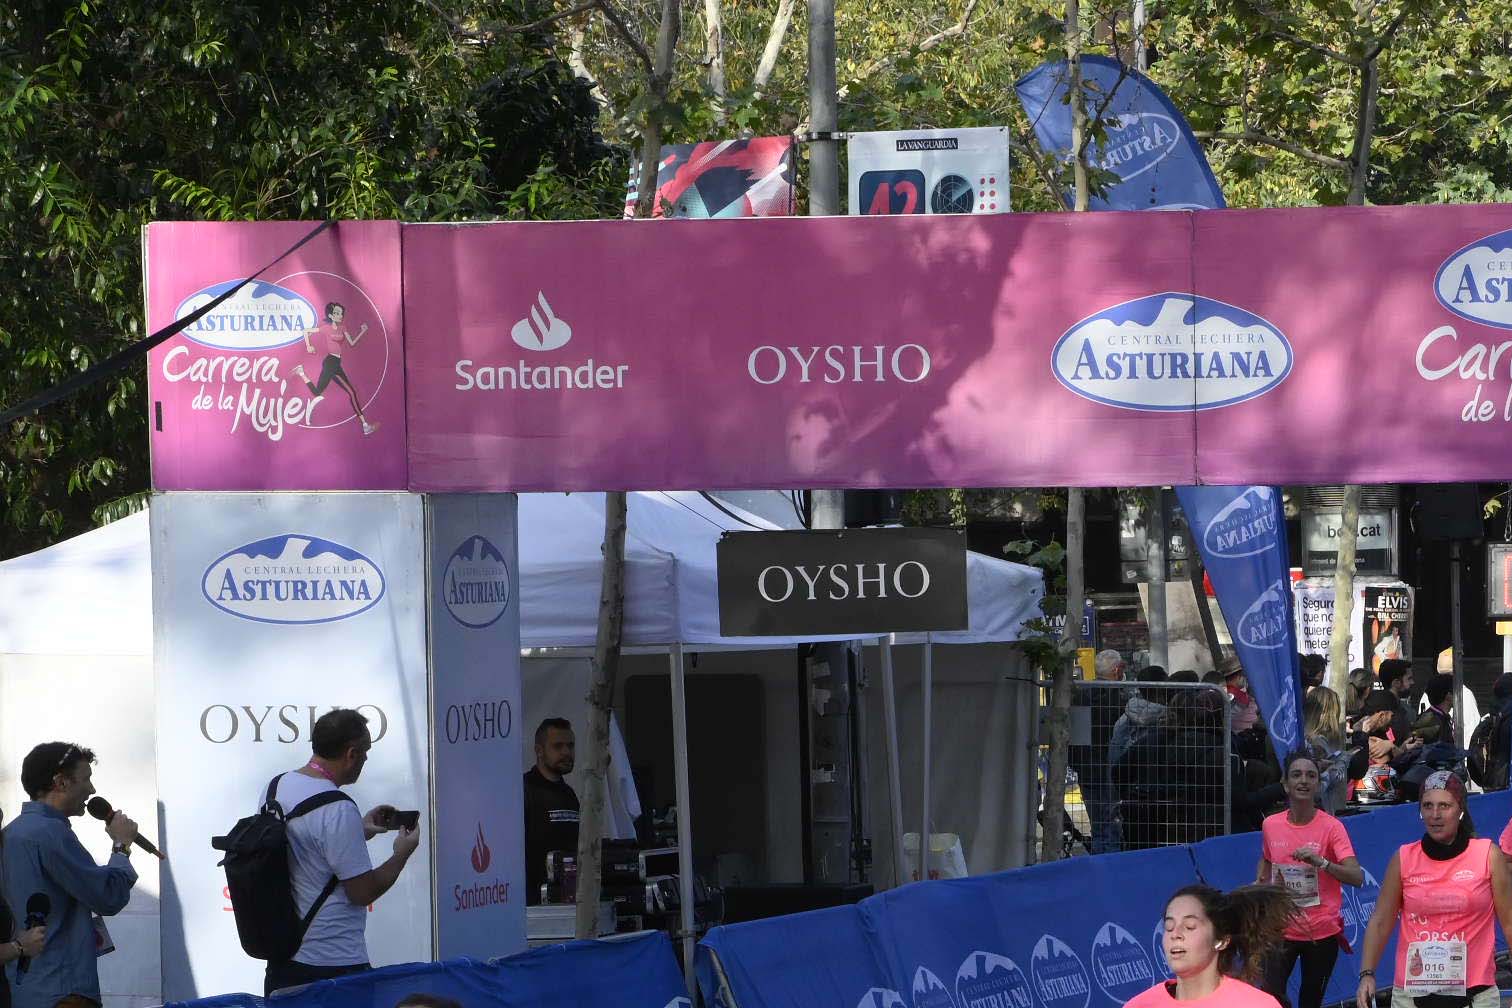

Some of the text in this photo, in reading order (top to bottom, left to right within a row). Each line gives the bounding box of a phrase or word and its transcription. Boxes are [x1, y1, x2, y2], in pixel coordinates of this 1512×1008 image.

[1107, 332, 1266, 346] CENTRAL LECHERA
[162, 345, 281, 383] Carrera
[455, 358, 630, 391] Santander
[747, 343, 932, 385] OYSHO
[1071, 337, 1274, 381] ASTURIANA
[191, 380, 325, 441] de la Mujer
[1461, 384, 1495, 423] de
[216, 568, 373, 601] ASTURIANA
[244, 565, 366, 575] CENTRAL LECHERA
[757, 560, 930, 603] OYSHO
[448, 573, 506, 606] ASTURIANA
[1303, 596, 1335, 610] Segur
[1377, 595, 1408, 609] ELVIS
[1303, 613, 1321, 623] que
[1304, 626, 1333, 637] quiere
[445, 700, 512, 744] OYSHO
[454, 878, 510, 912] Santander
[1099, 960, 1152, 988] ASTURIANA
[1424, 963, 1445, 972] 016
[1039, 973, 1088, 1001] ASTURIANA
